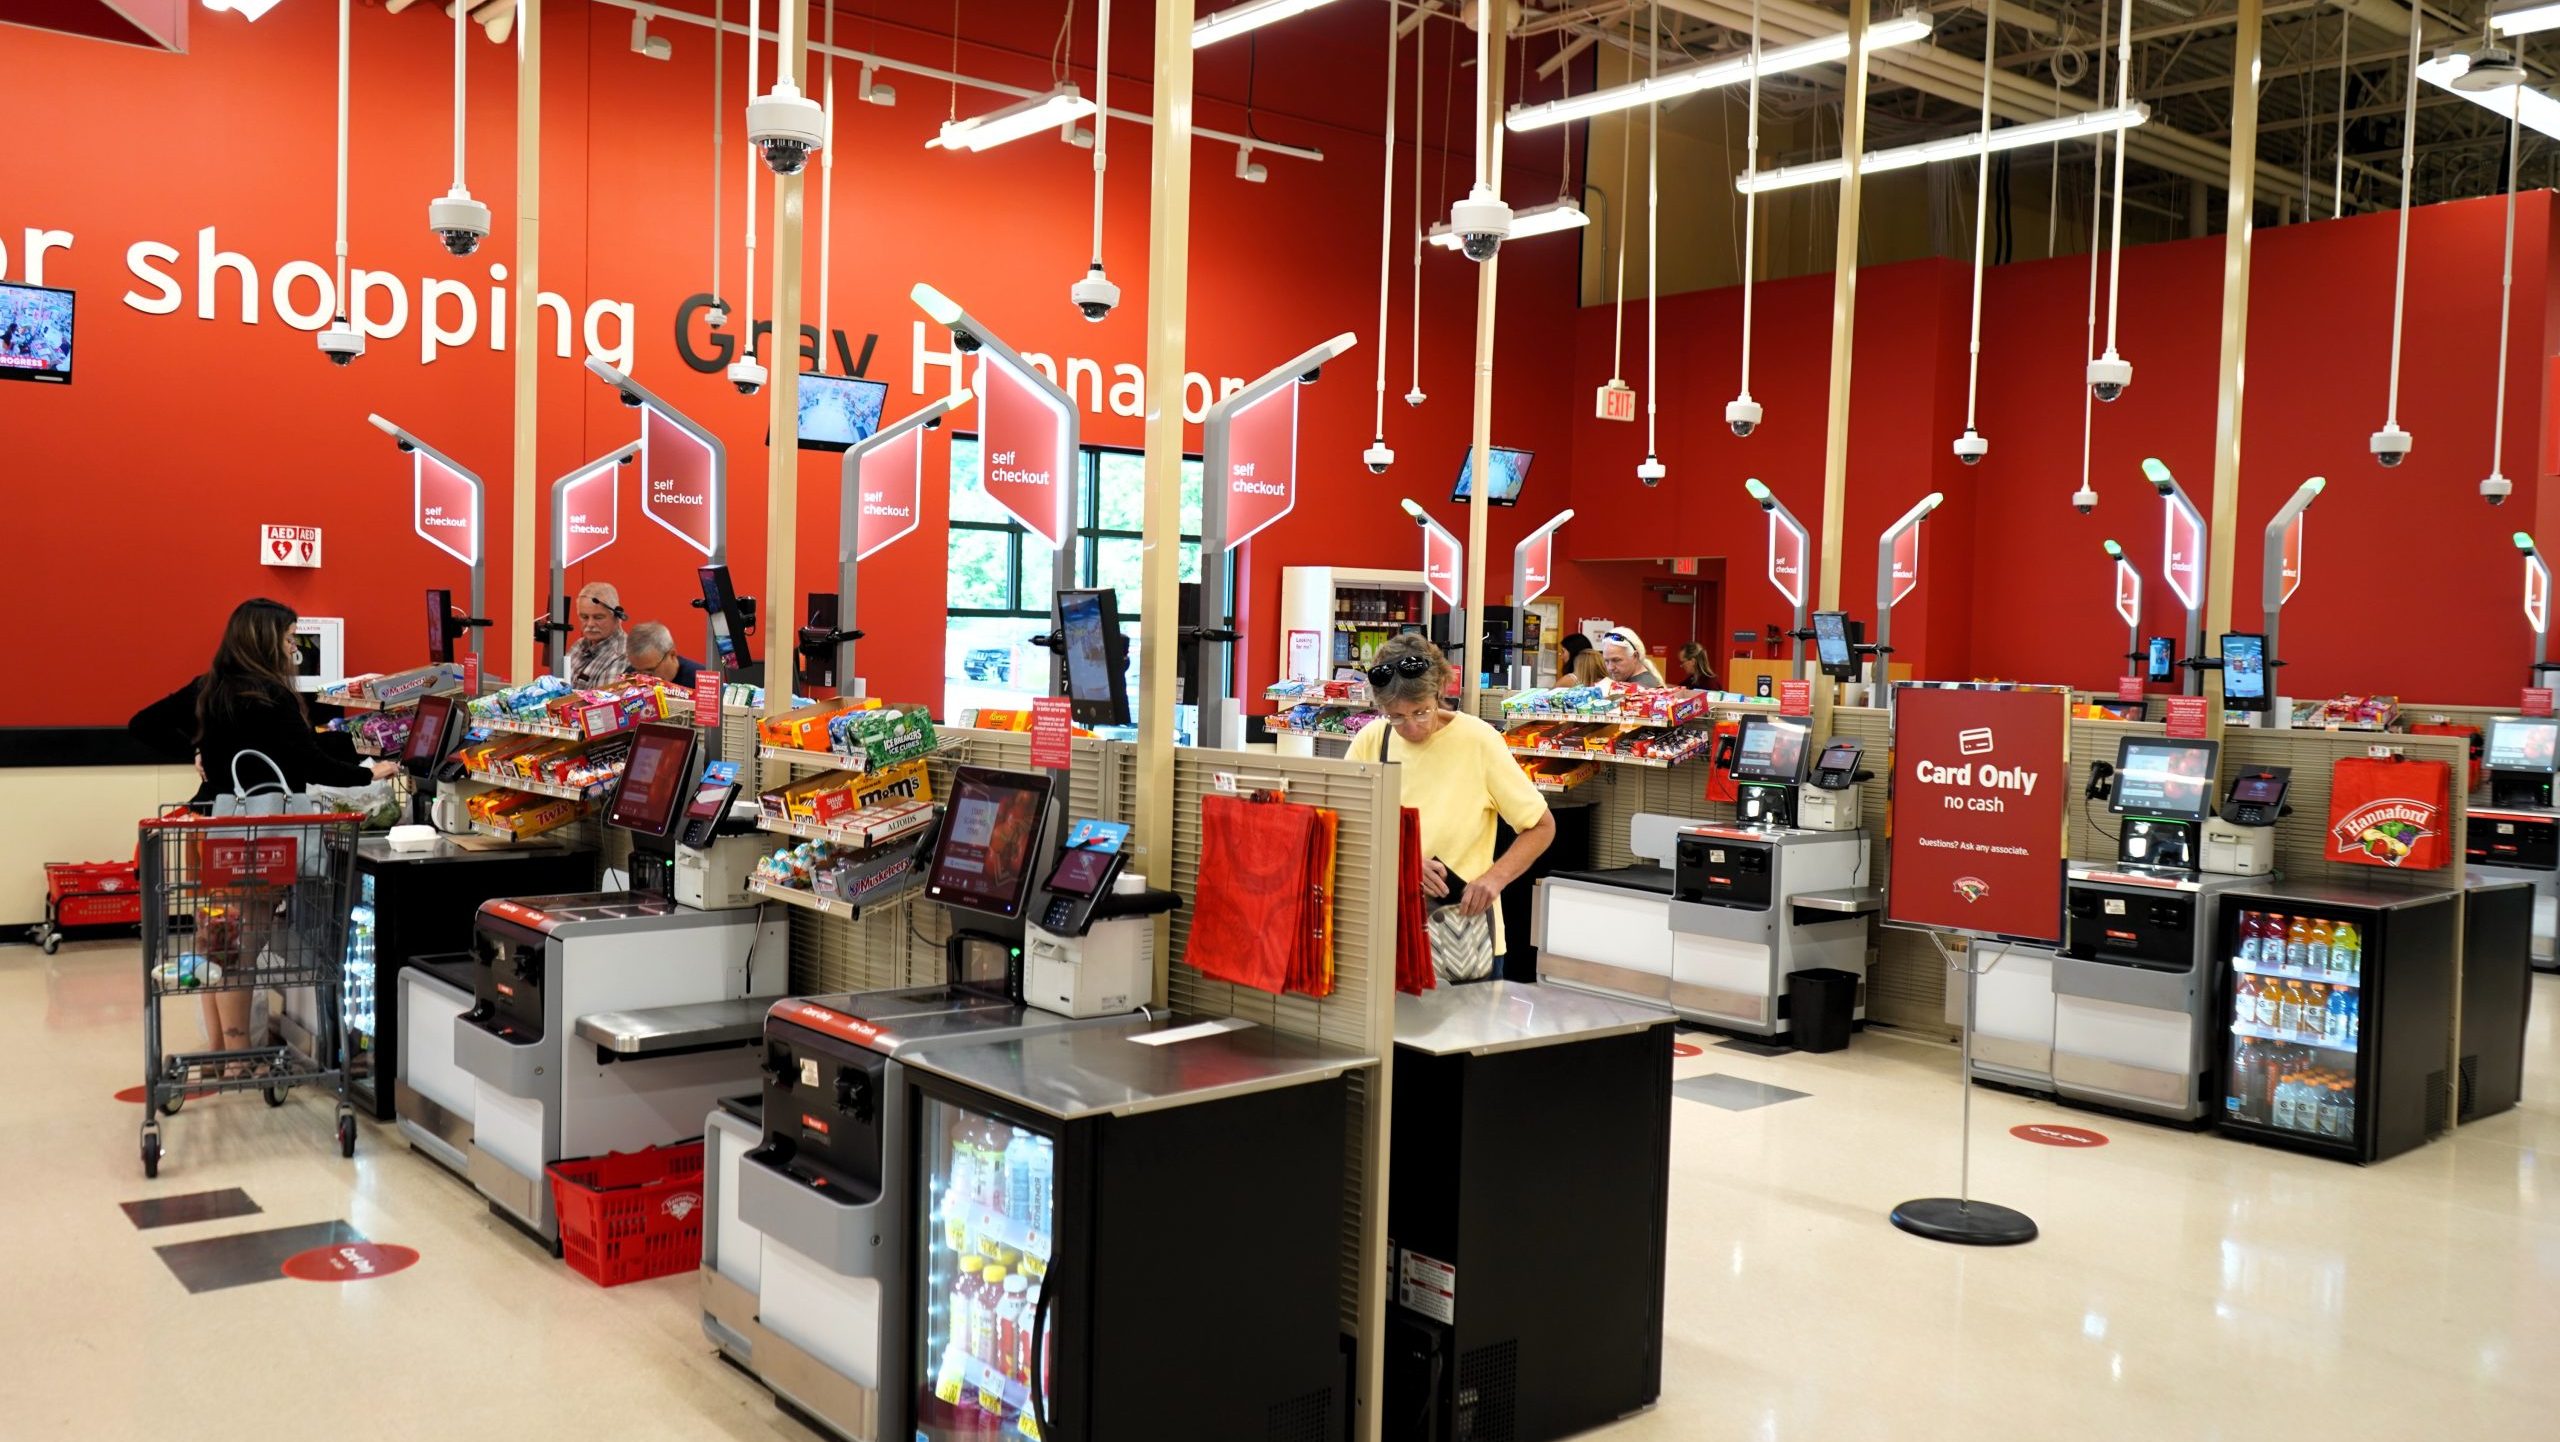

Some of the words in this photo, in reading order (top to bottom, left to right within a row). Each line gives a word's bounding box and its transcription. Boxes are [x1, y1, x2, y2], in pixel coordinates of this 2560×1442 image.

[0, 227, 74, 286] r
[123, 225, 635, 384] shopping
[1607, 390, 1632, 417] EXIT
[992, 451, 1015, 465] self
[992, 468, 1050, 485] checkout
[1233, 463, 1255, 477] self
[654, 479, 674, 490] self
[1233, 480, 1285, 496] checkout
[654, 493, 703, 505] checkout
[864, 491, 883, 503] self
[425, 507, 442, 516] self
[864, 504, 909, 517] checkout
[425, 516, 467, 527] checkout
[570, 514, 587, 524] self
[271, 527, 295, 539] AED
[300, 528, 315, 541] AED
[569, 524, 609, 535] checkout
[1776, 566, 1797, 574] checkout
[883, 738, 894, 752] ICE
[894, 729, 922, 746] BREAKERS
[889, 747, 900, 755] ICE
[900, 740, 920, 752] CUBES
[1916, 760, 1972, 786] Card
[1979, 764, 2038, 795] Only
[1944, 796, 1964, 810] no
[1967, 796, 2004, 813] cash
[887, 815, 917, 832] ALTOIDS
[2344, 804, 2430, 837] Hannaford
[1919, 837, 1959, 850] Questions?
[1960, 841, 1975, 851] Ask
[1975, 845, 1989, 853] any
[1990, 845, 2029, 856] associate.
[860, 857, 910, 892] Musketeers
